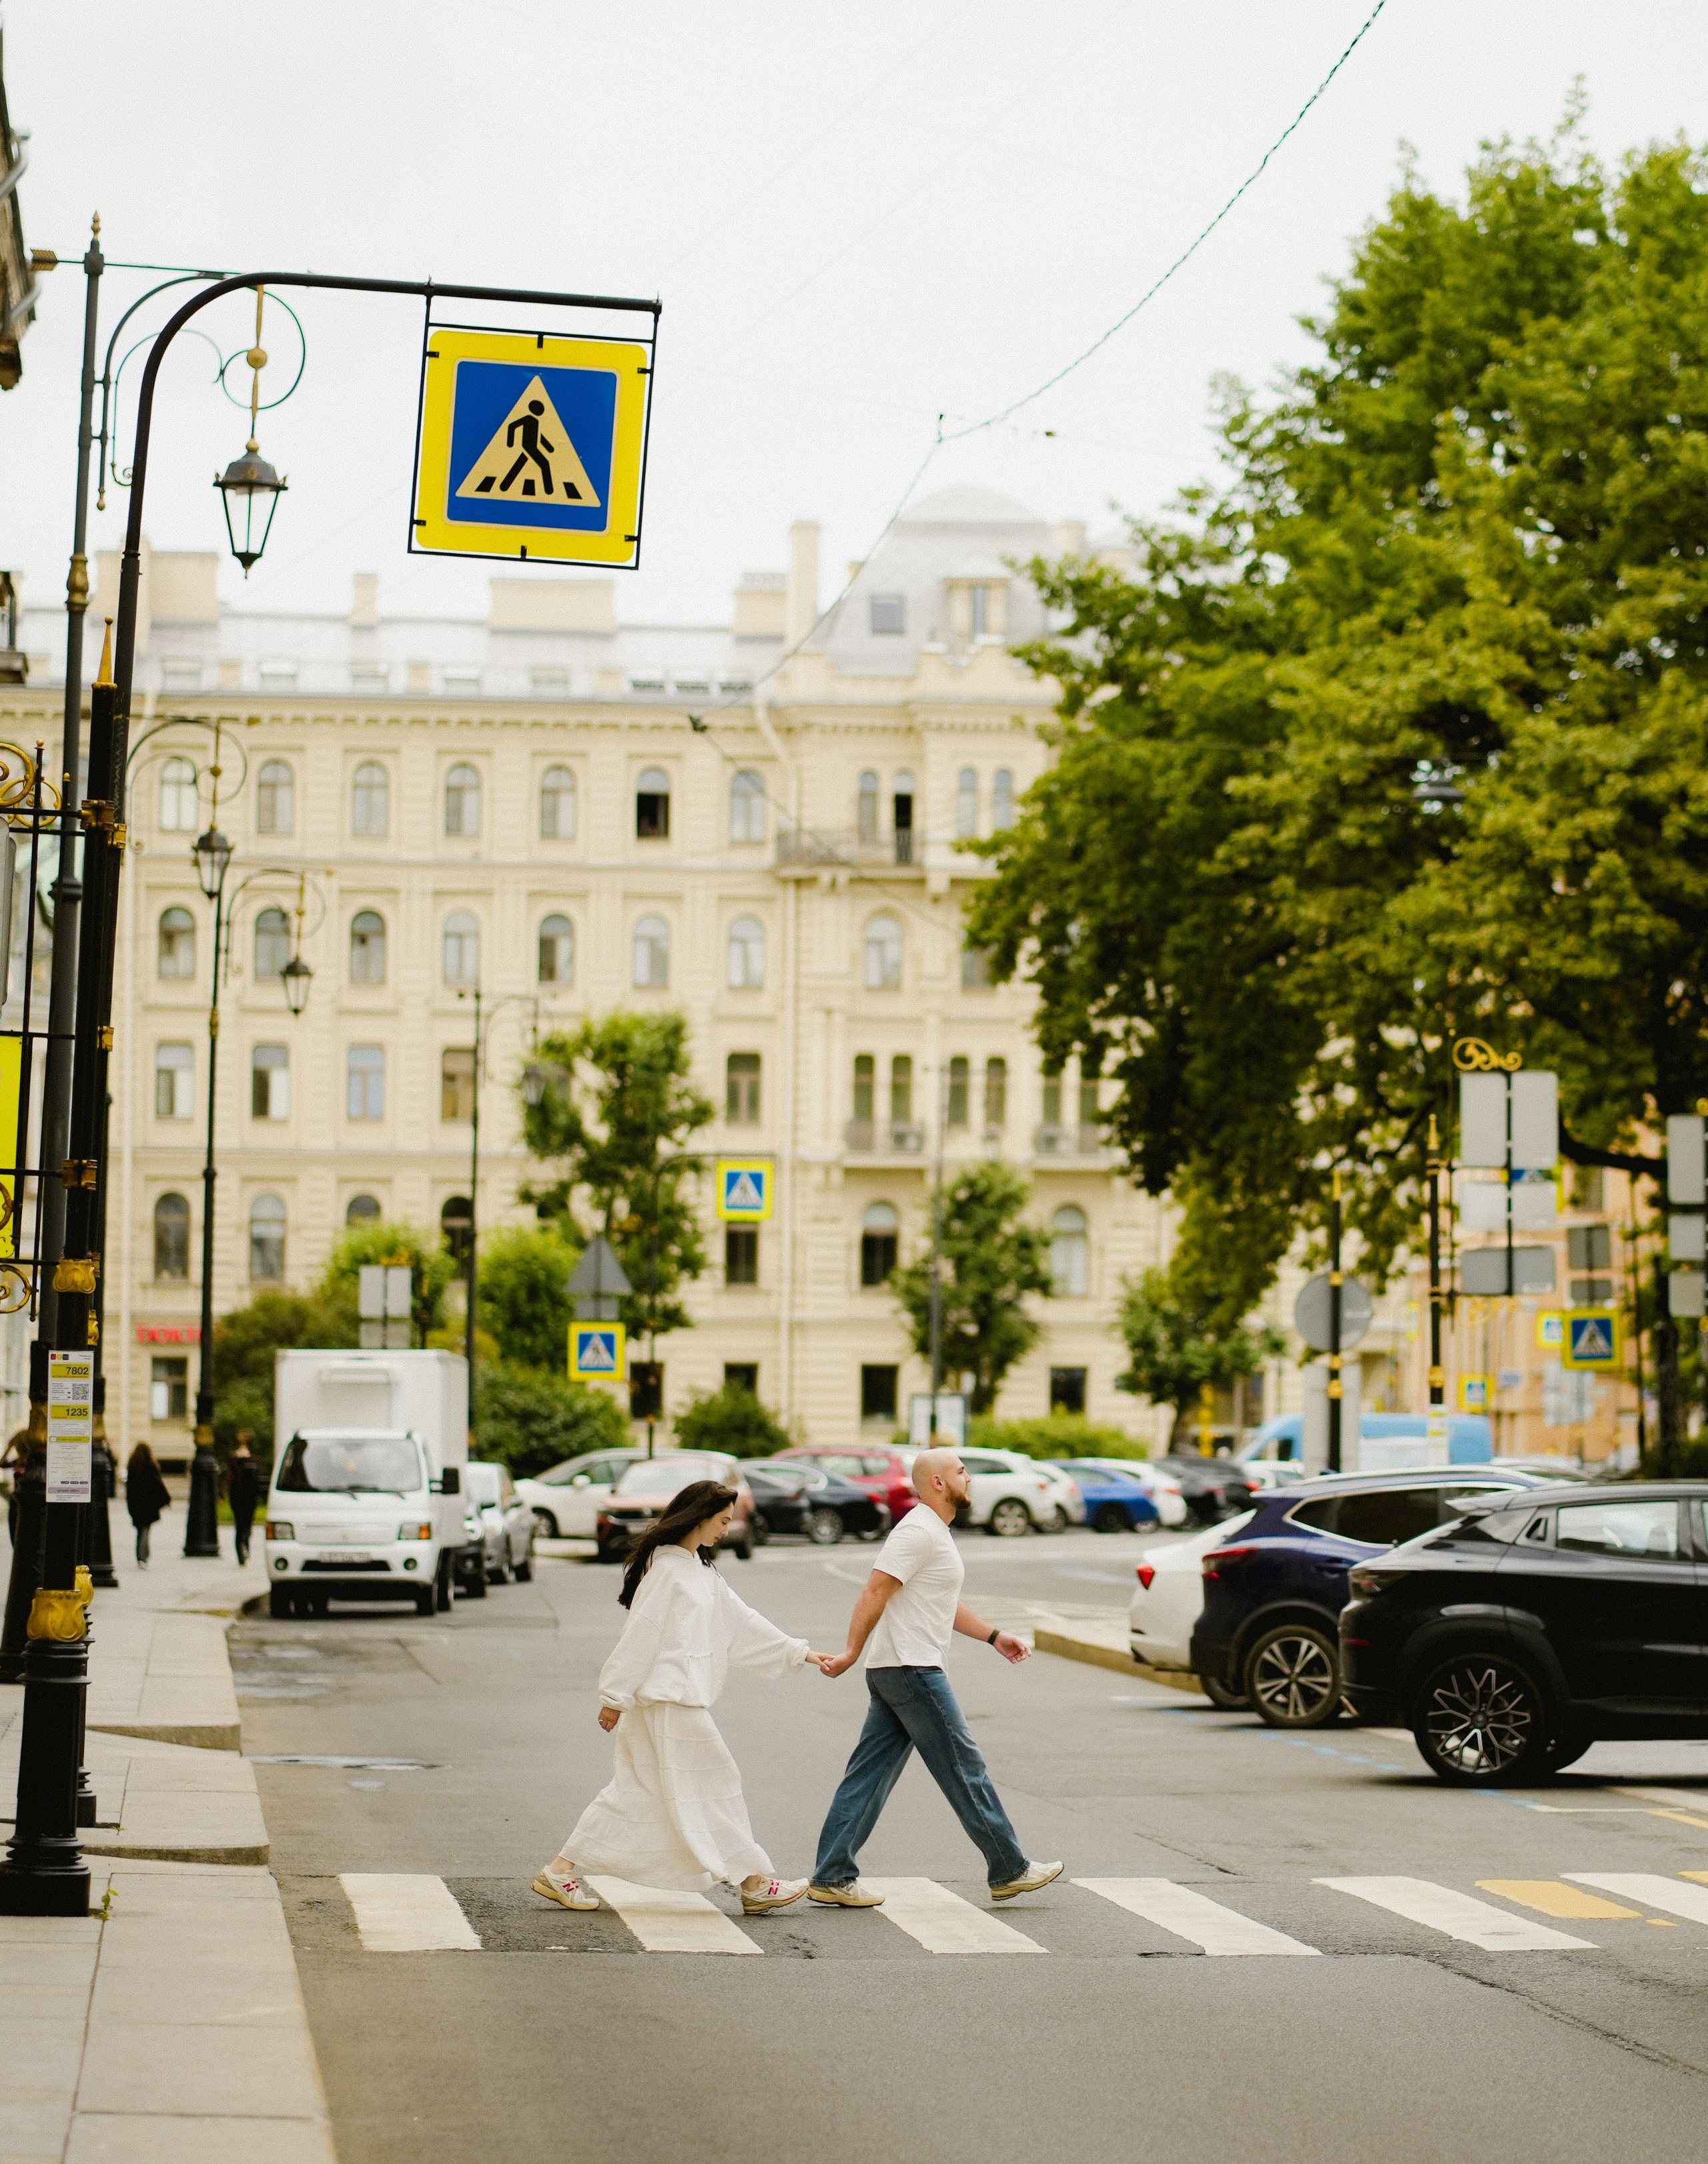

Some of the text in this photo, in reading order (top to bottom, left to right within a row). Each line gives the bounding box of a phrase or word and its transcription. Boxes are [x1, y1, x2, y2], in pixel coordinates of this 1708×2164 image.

[66, 1367, 89, 1375] 7802
[65, 1408, 88, 1417] 1235
[562, 1882, 574, 1892] N
[767, 1886, 779, 1895] N
